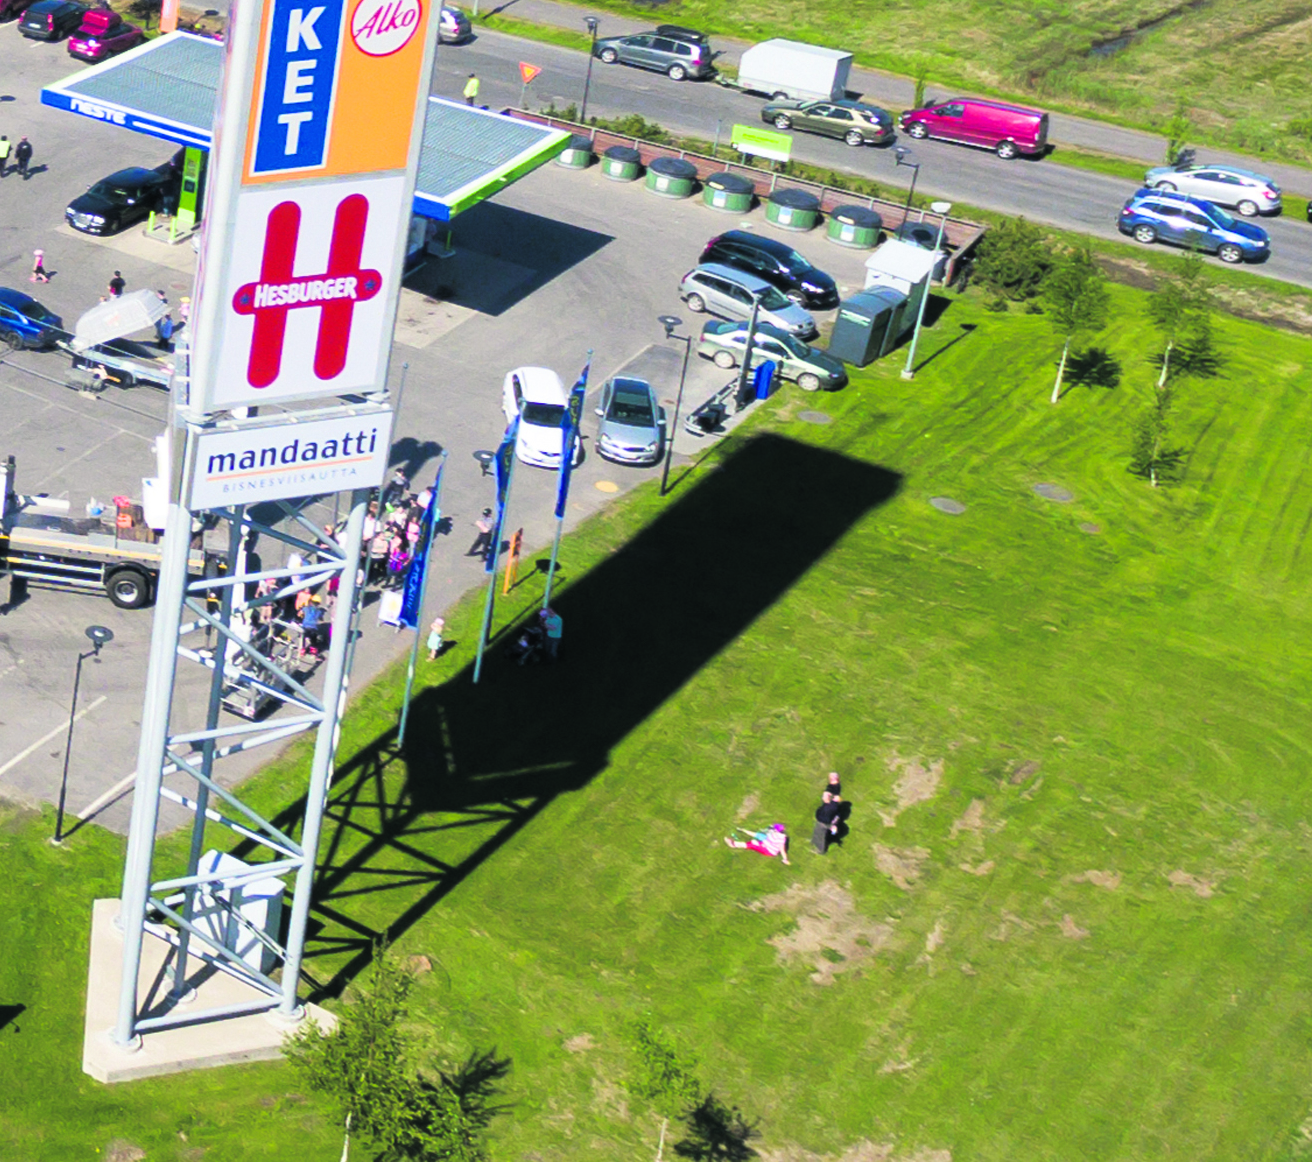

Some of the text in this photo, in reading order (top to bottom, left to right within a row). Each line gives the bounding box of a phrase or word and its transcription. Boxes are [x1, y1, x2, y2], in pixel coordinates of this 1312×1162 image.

[354, 0, 417, 39] Alko
[253, 276, 358, 308] HESBURGER
[207, 428, 378, 475] mandaatti
[222, 467, 358, 493] BISNESVIISAUTTA
